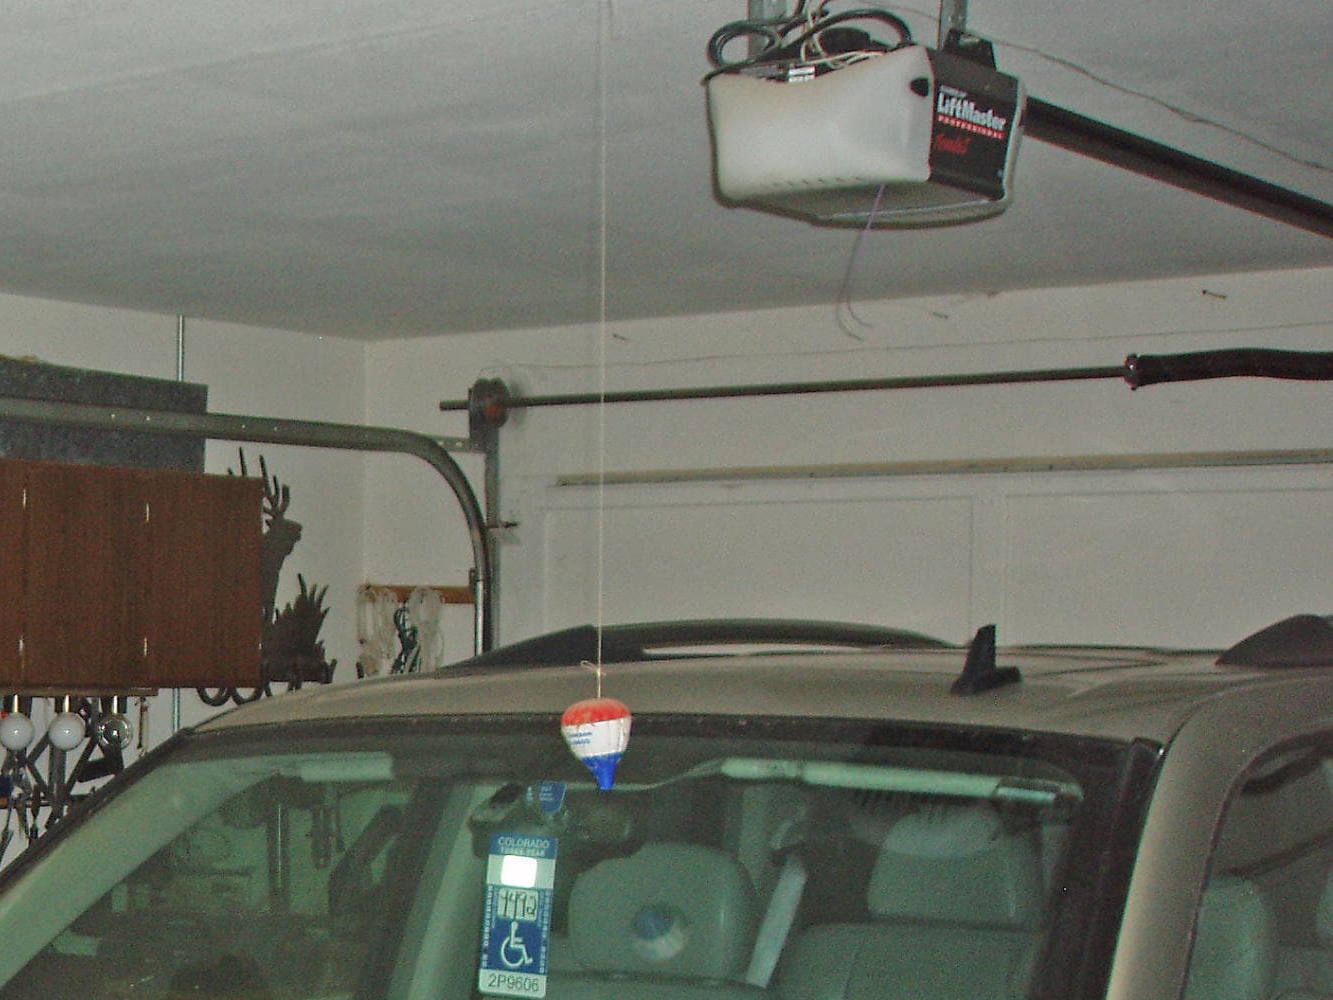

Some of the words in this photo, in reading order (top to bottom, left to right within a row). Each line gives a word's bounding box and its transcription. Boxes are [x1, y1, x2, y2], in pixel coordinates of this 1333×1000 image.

[937, 92, 1006, 131] LiftMaster
[498, 836, 550, 849] COLORADO
[488, 974, 540, 993] 2P9606
